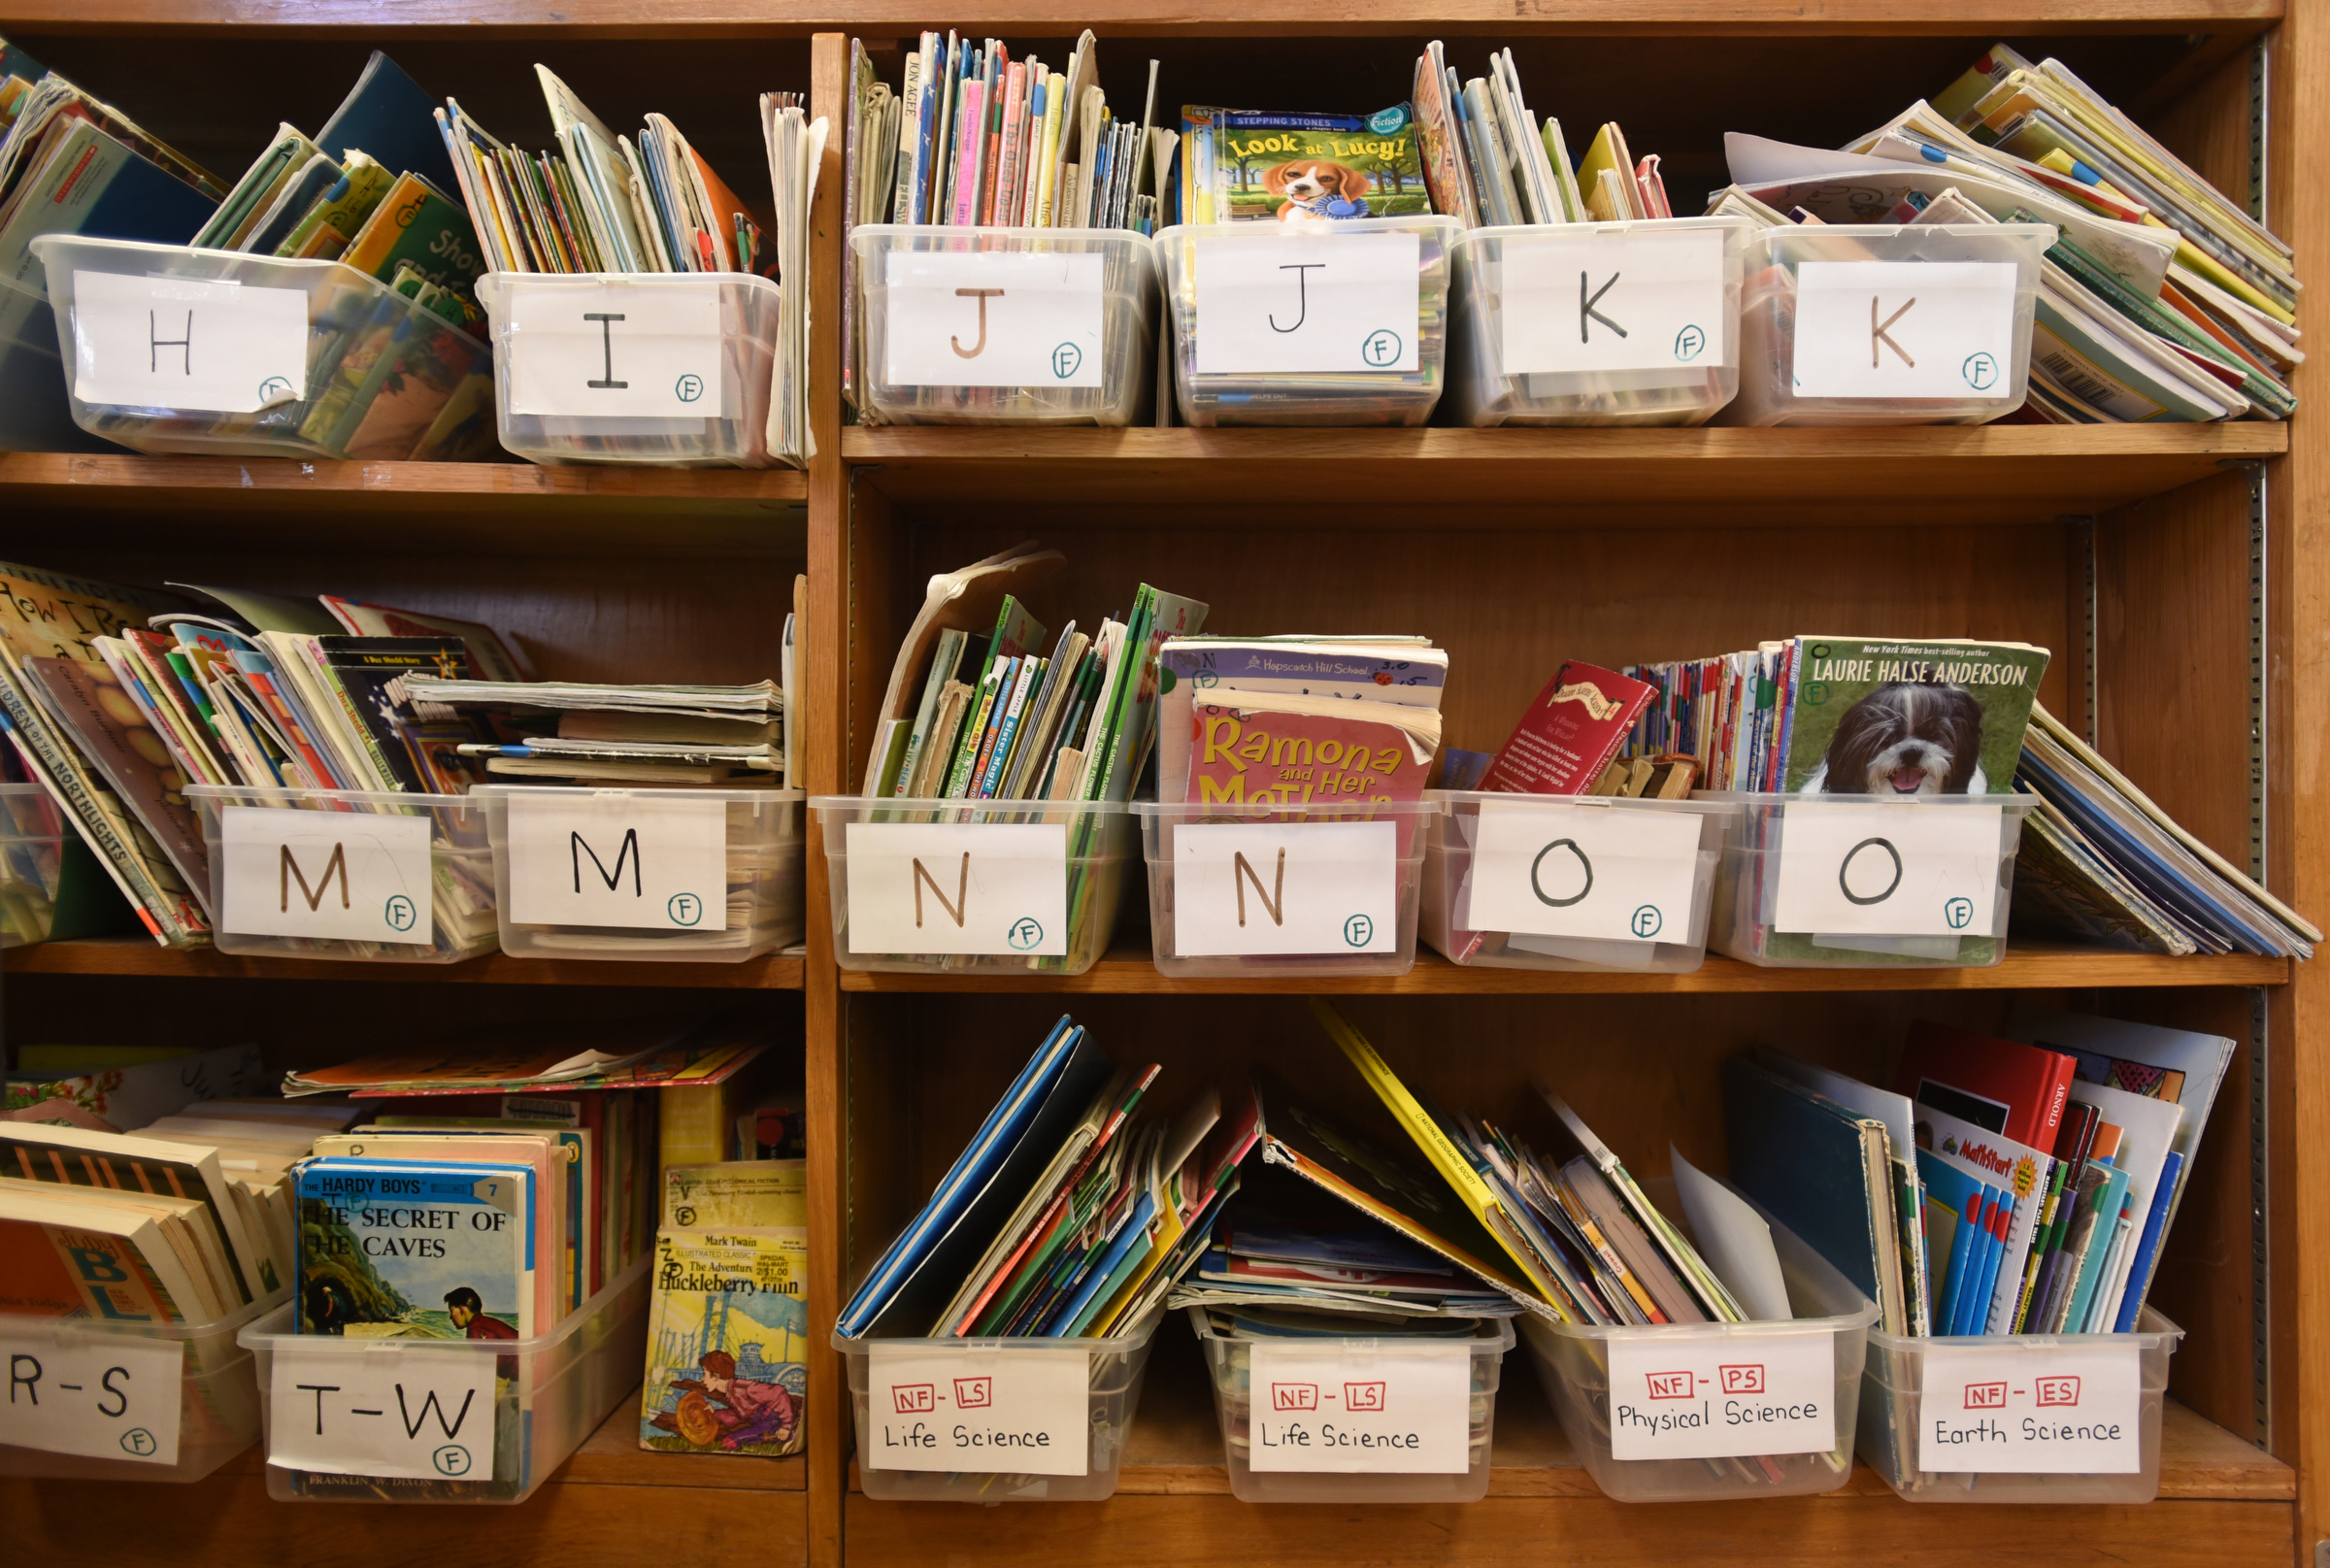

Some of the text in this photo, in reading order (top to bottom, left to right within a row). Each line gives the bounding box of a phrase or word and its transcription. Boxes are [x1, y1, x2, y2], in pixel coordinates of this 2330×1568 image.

[904, 60, 920, 117] JON AGEE
[1048, 107, 1058, 136] Hughes
[1291, 117, 1330, 126] STONES
[1371, 114, 1402, 129] Fiction
[1228, 134, 1406, 160] Look at Lucy!
[43, 138, 87, 198] www.scholastic.com
[54, 152, 91, 203] SCHOLASTIC
[1024, 193, 1033, 224] GROUCHY
[1269, 263, 1326, 333] J
[1581, 270, 1627, 344] K
[951, 287, 1004, 359] J
[1872, 295, 1915, 368] K
[150, 310, 192, 376] H
[582, 313, 628, 389] I
[1203, 652, 1215, 669] N
[1789, 645, 1801, 684] ANDERSON
[1863, 645, 1989, 657] New York Times best-selling author
[1264, 658, 1369, 676] Hopscotch Hill School
[1814, 659, 2028, 685] LAURIE HALSE ANDERSON
[1012, 674, 1029, 713] LITTLE APPLE
[56, 662, 127, 755] Caralyn Buehner
[336, 690, 365, 735] Duz Shedd
[1608, 705, 1616, 717] 4
[982, 733, 994, 756] DADEY
[984, 719, 1015, 789] Sister Magic
[1092, 742, 1103, 768] CACTUS
[1204, 717, 1404, 776] Ramona
[1606, 730, 1627, 757] DRAGON
[898, 766, 910, 785] BEAN
[945, 731, 970, 798] THE CACTUS FLOWER
[1105, 749, 1116, 774] CACTUS
[1084, 770, 1096, 796] FLOWER
[1279, 767, 1377, 794] and Her
[50, 761, 128, 864] NORTHLIGHTS
[572, 829, 641, 897] M
[1531, 838, 1592, 907] O
[1839, 837, 1903, 905] O
[282, 842, 350, 914] M
[913, 851, 970, 928] N
[1235, 847, 1286, 927] N
[2047, 1083, 2066, 1127] ARNOLD
[1420, 1117, 1439, 1138] NATIONAL
[1436, 1137, 1461, 1166] GEOGRAPHIC
[1458, 1164, 1476, 1185] SOCIETY
[1957, 1139, 2014, 1176] MathStart
[304, 1178, 420, 1194] THE HARDY BOYS
[487, 1184, 497, 1196] 7
[681, 1186, 690, 1200] V
[304, 1206, 507, 1232] THE SECRET OF
[304, 1236, 446, 1257] THE CAVES
[676, 1250, 721, 1258] ILLUSTRATED
[705, 1236, 756, 1247] Mark Twain
[689, 1262, 706, 1272] The
[1602, 1250, 1622, 1273] Crowell
[658, 1272, 756, 1296] Huckleberry
[1618, 1401, 1818, 1436] Physical Science
[1937, 1418, 2121, 1444] Earth Science
[885, 1425, 1050, 1449] Life Science
[1261, 1424, 1420, 1449] Life Science
[309, 1475, 432, 1487] FRANKLIN W. DIXON
